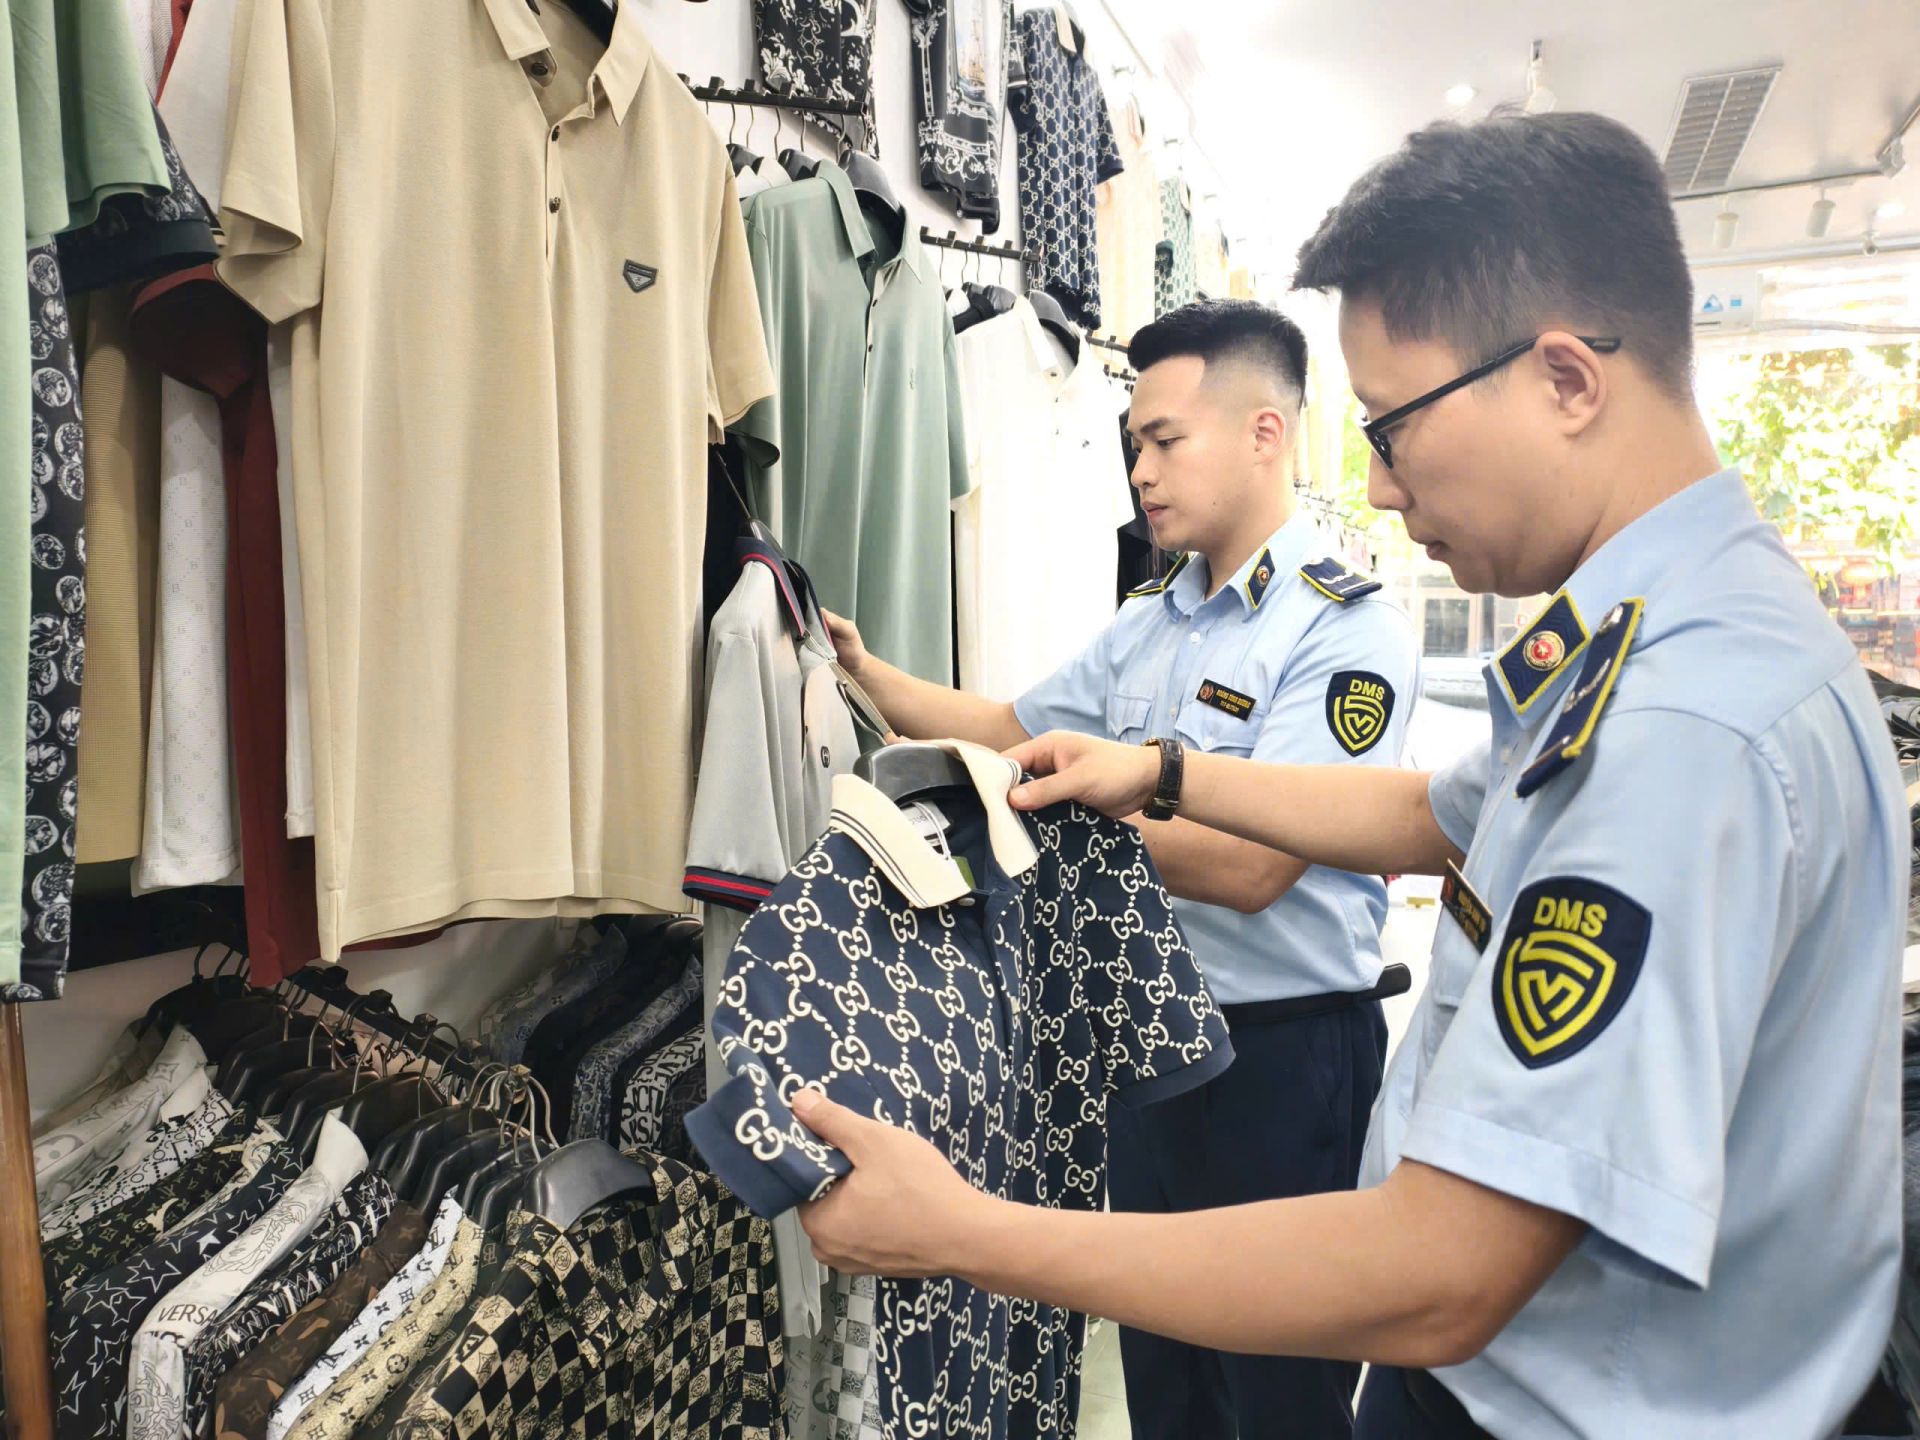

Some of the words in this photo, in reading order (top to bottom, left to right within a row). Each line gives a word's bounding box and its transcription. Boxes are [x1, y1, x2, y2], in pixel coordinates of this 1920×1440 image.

[1350, 679, 1385, 701] DMS
[1534, 897, 1608, 938] DMS
[158, 1304, 218, 1326] VERSA
